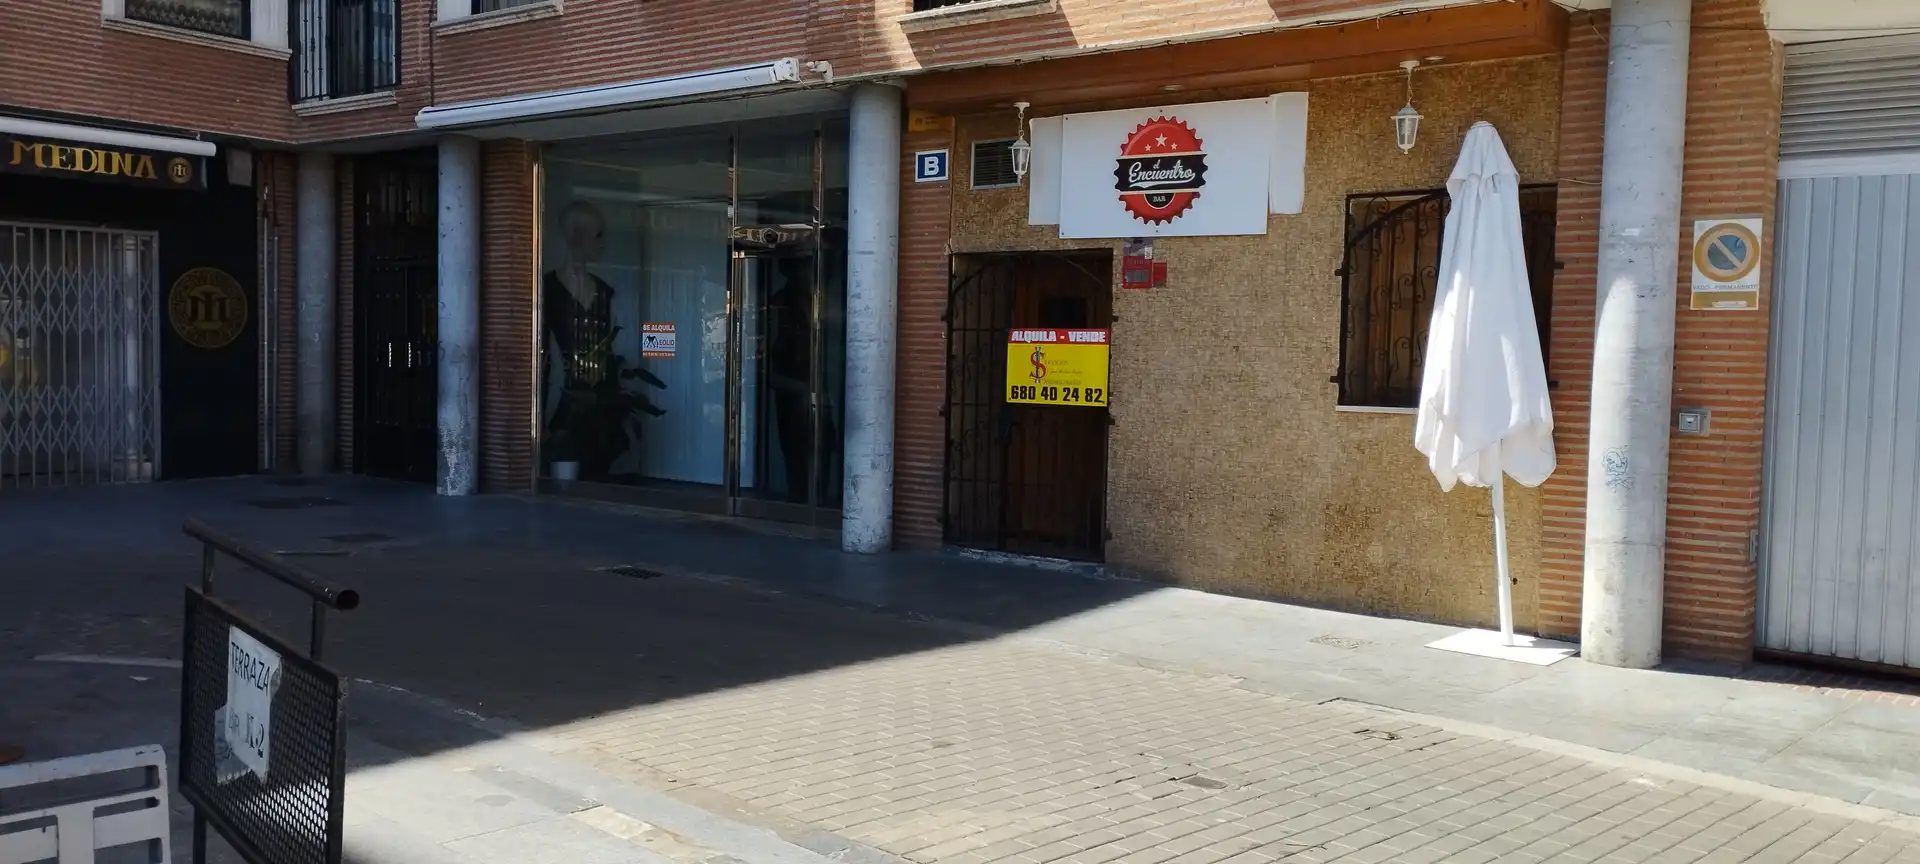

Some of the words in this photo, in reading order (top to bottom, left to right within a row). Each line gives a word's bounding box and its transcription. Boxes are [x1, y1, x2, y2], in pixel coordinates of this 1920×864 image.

[8, 140, 158, 179] MEDINA
[924, 156, 940, 176] B
[1153, 160, 1161, 169] el
[1129, 160, 1196, 184] Encuentro
[1152, 195, 1167, 203] BAR
[651, 324, 675, 332] ALQUILA
[1011, 331, 1057, 343] ALQUILA
[1068, 331, 1106, 343] VENDE
[1011, 385, 1036, 400] 680
[1041, 386, 1058, 401] 40
[1062, 387, 1079, 402] 24
[1085, 388, 1103, 403] 82
[231, 642, 271, 697] TERRAZA
